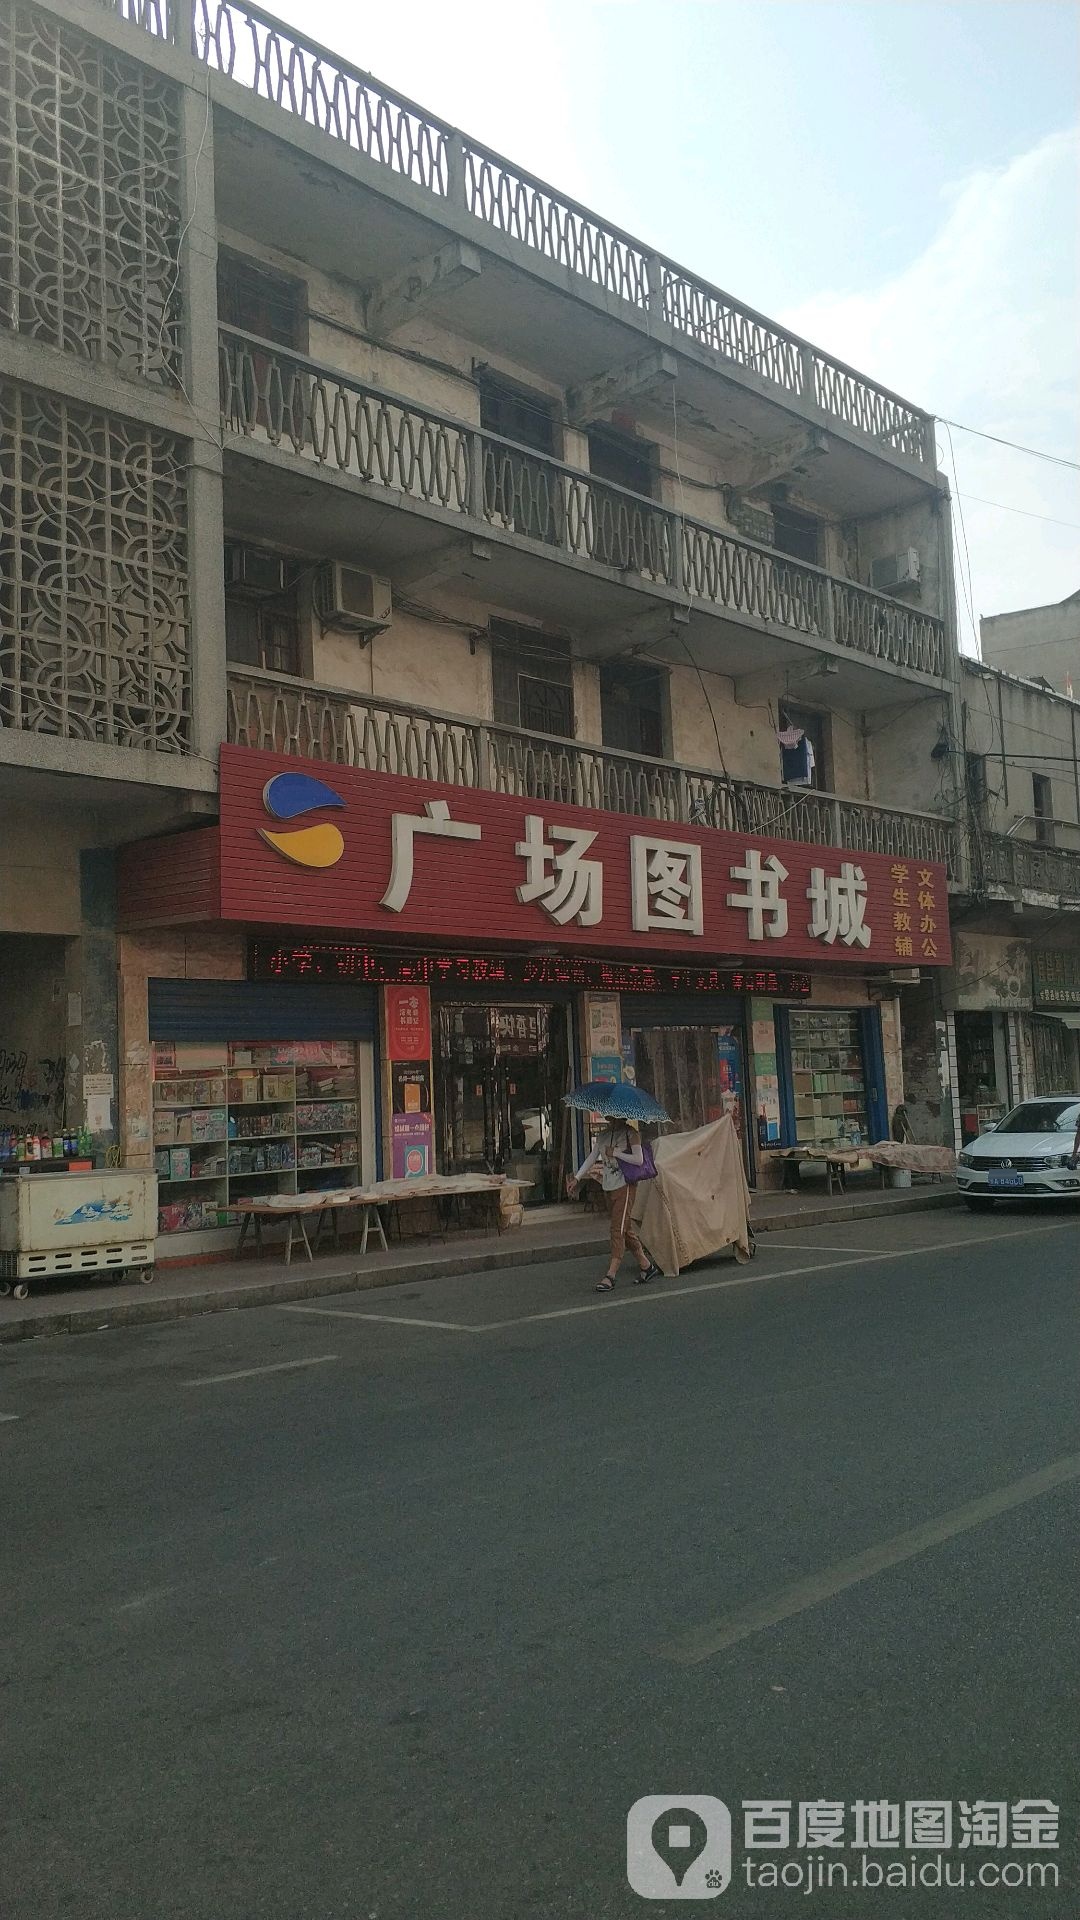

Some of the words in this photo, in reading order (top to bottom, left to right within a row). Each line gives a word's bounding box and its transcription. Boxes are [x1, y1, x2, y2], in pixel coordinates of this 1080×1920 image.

[378, 800, 872, 949] 广场图书城
[890, 864, 913, 956] 学生教辅
[917, 868, 938, 957] 文体办公
